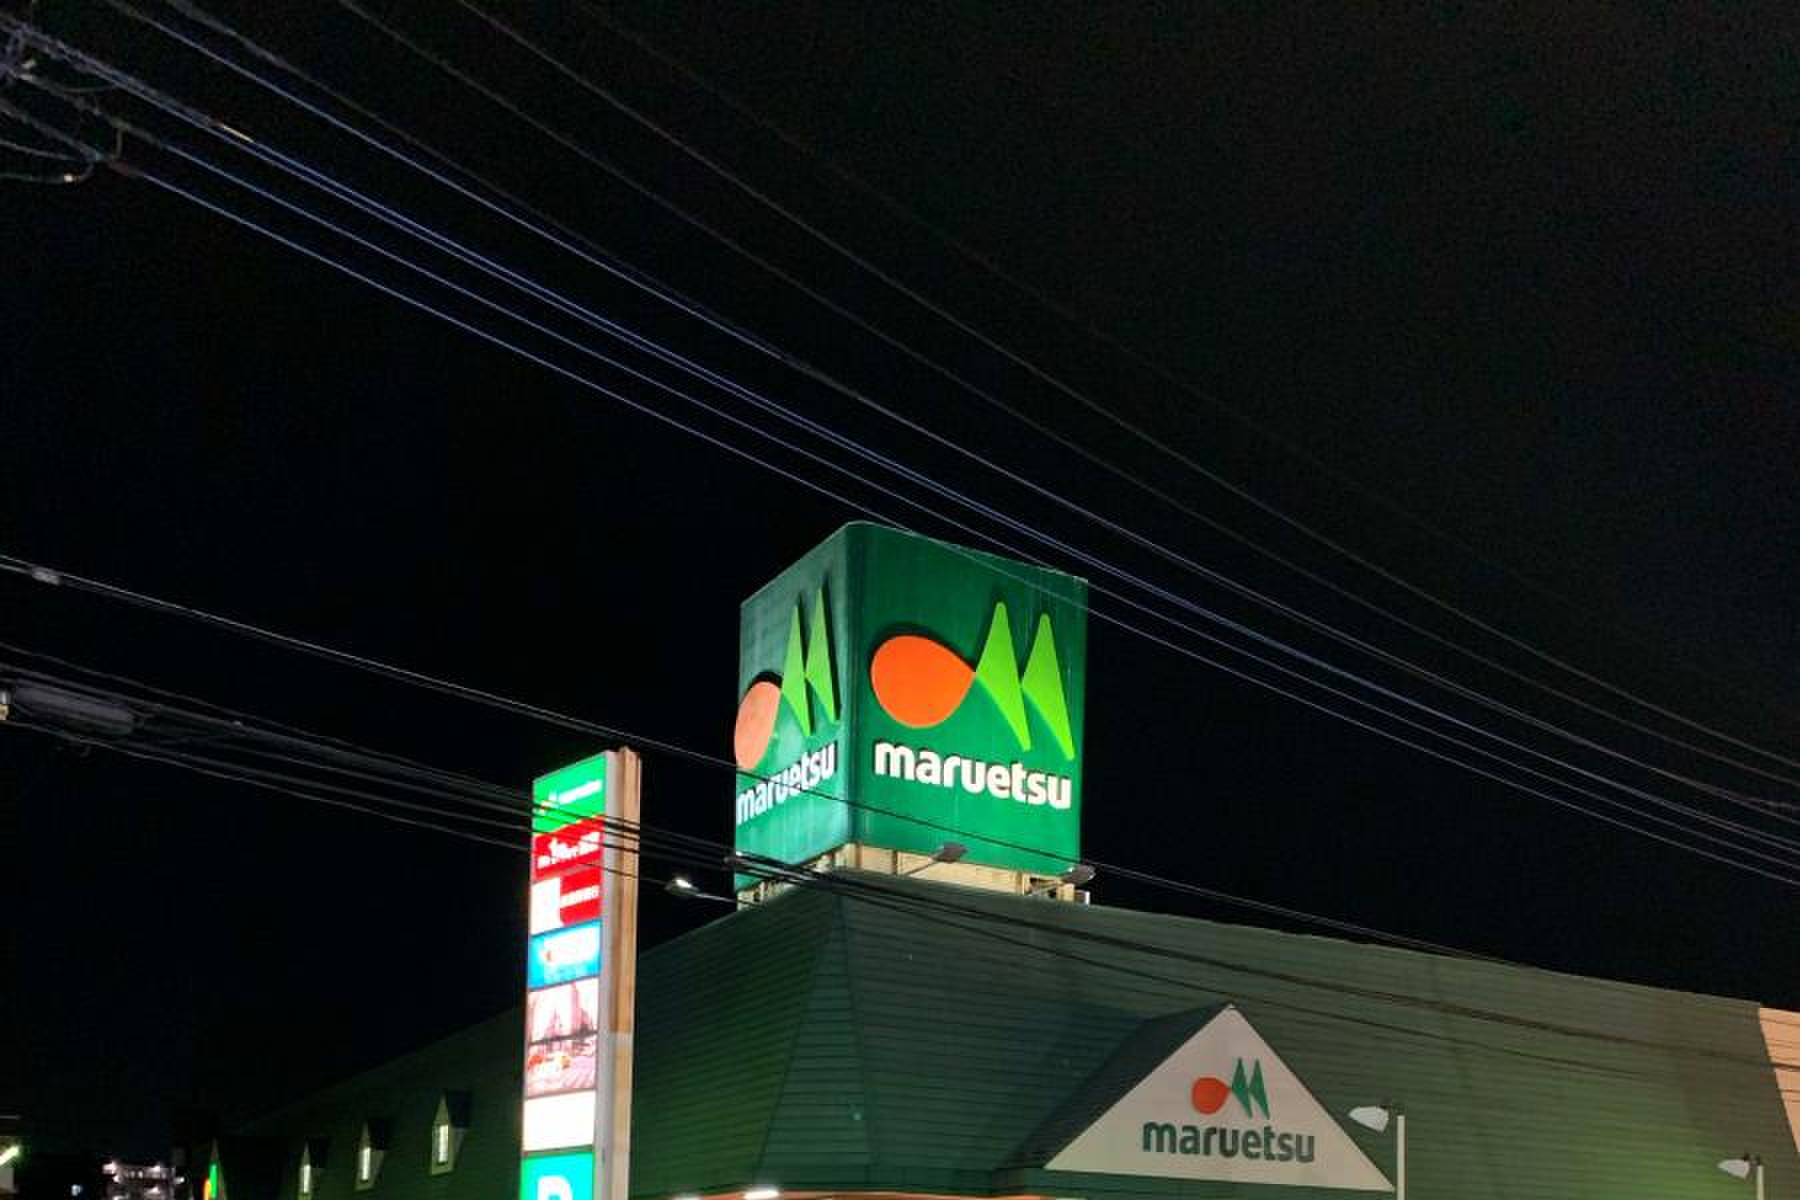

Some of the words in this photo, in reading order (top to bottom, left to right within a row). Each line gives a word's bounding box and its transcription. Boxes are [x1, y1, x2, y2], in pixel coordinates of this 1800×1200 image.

[737, 742, 836, 825] maruetsu
[874, 740, 1072, 810] maruetsu
[1143, 1121, 1315, 1163] maruetsu
